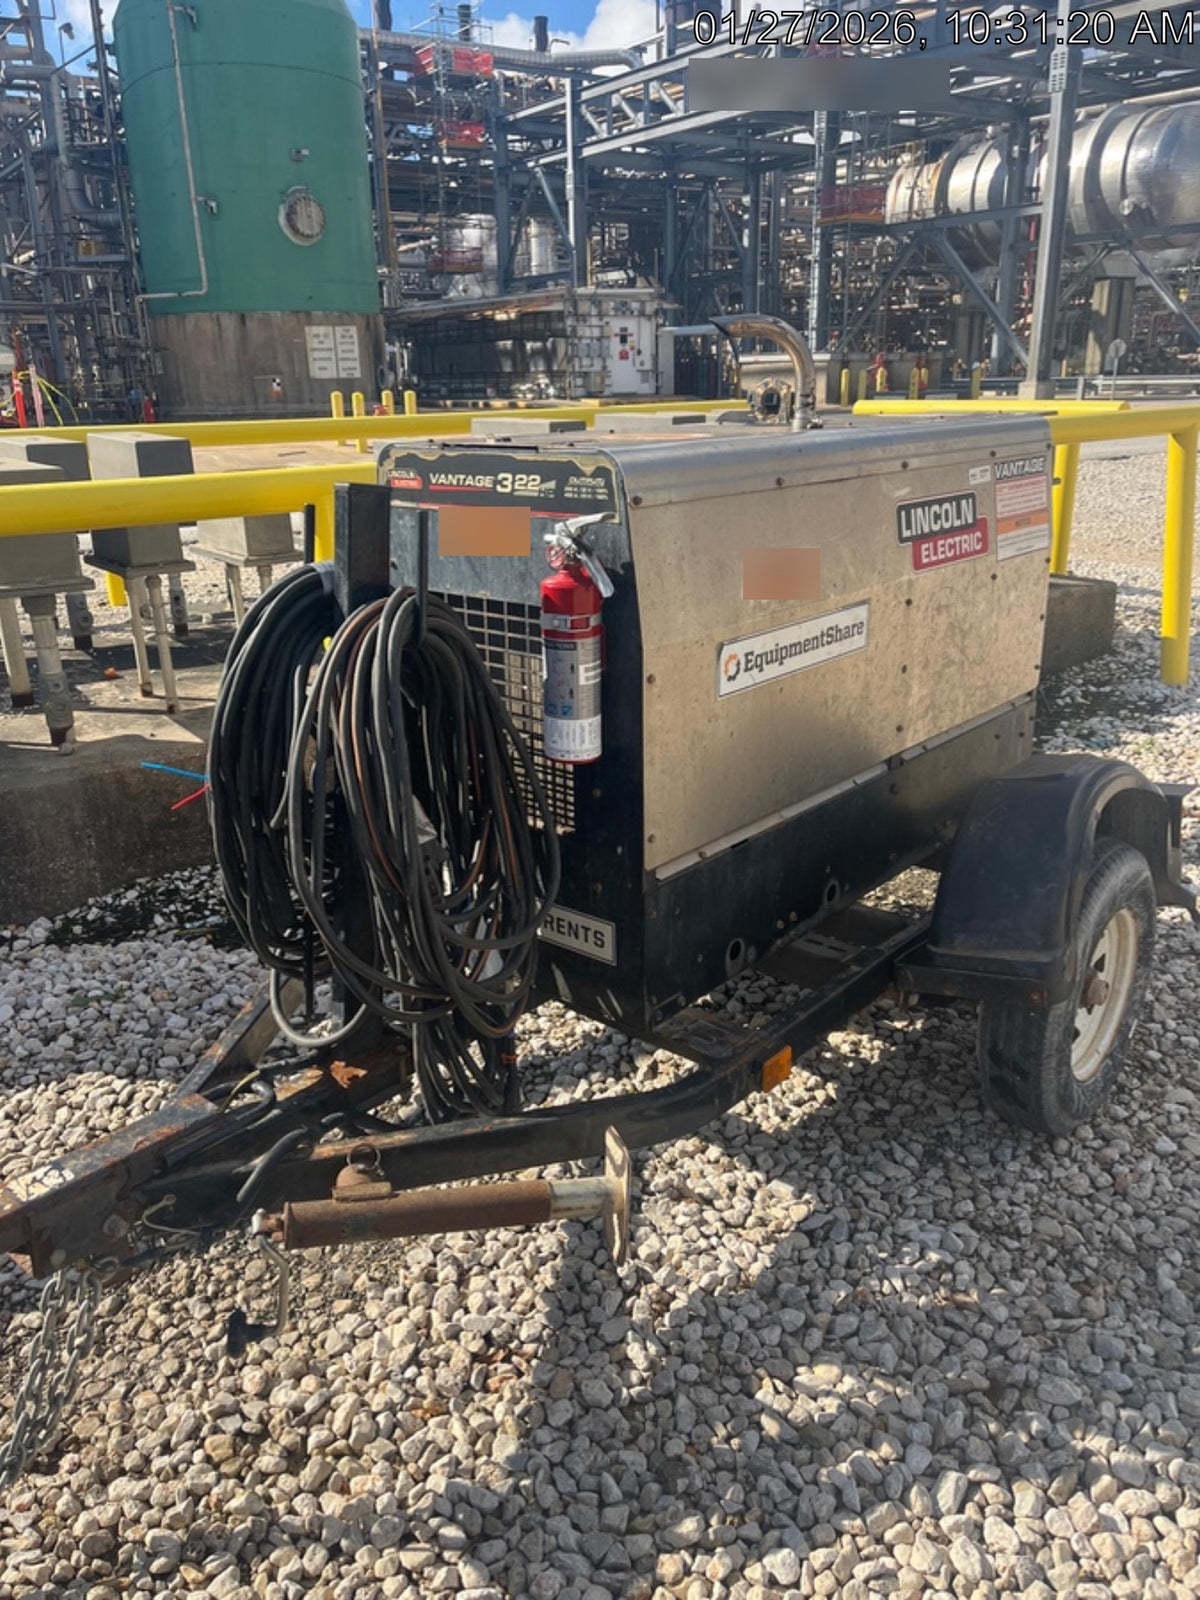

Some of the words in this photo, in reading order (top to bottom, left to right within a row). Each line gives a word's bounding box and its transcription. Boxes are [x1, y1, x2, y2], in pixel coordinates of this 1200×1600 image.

[429, 472, 495, 487] VANTAGE
[496, 472, 542, 494] 322
[994, 456, 1046, 480] VANTAGE
[901, 497, 975, 538] LINCOLN
[920, 531, 984, 565] ELECTRIC
[743, 620, 865, 673] EquipmentShare
[543, 914, 606, 948] RENTS
